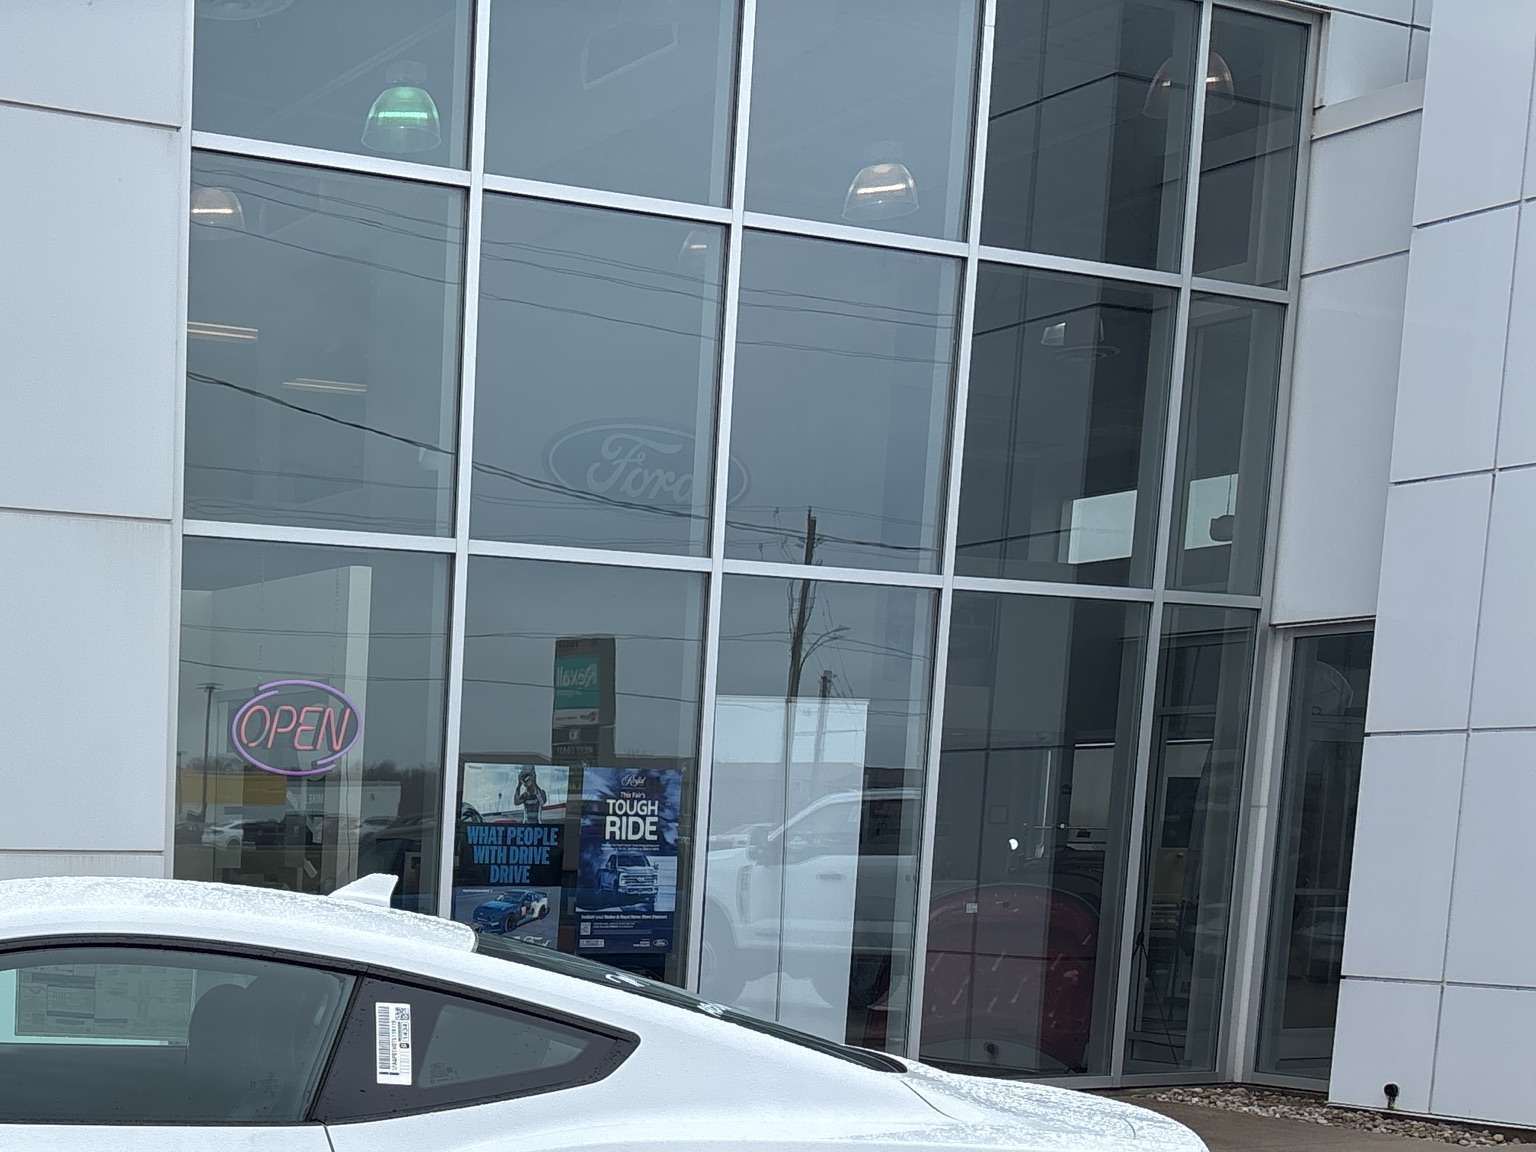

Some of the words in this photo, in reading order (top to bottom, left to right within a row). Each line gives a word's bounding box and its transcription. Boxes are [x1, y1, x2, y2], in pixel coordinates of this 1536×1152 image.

[240, 704, 351, 752] OPEN
[606, 799, 659, 816] TOUGH
[467, 826, 505, 846] WHAT
[506, 827, 559, 846] PEOPLE
[605, 815, 659, 840] RIDE
[473, 846, 508, 864] WITH
[509, 846, 550, 865] DRIVE
[489, 865, 531, 884] DRIVE
